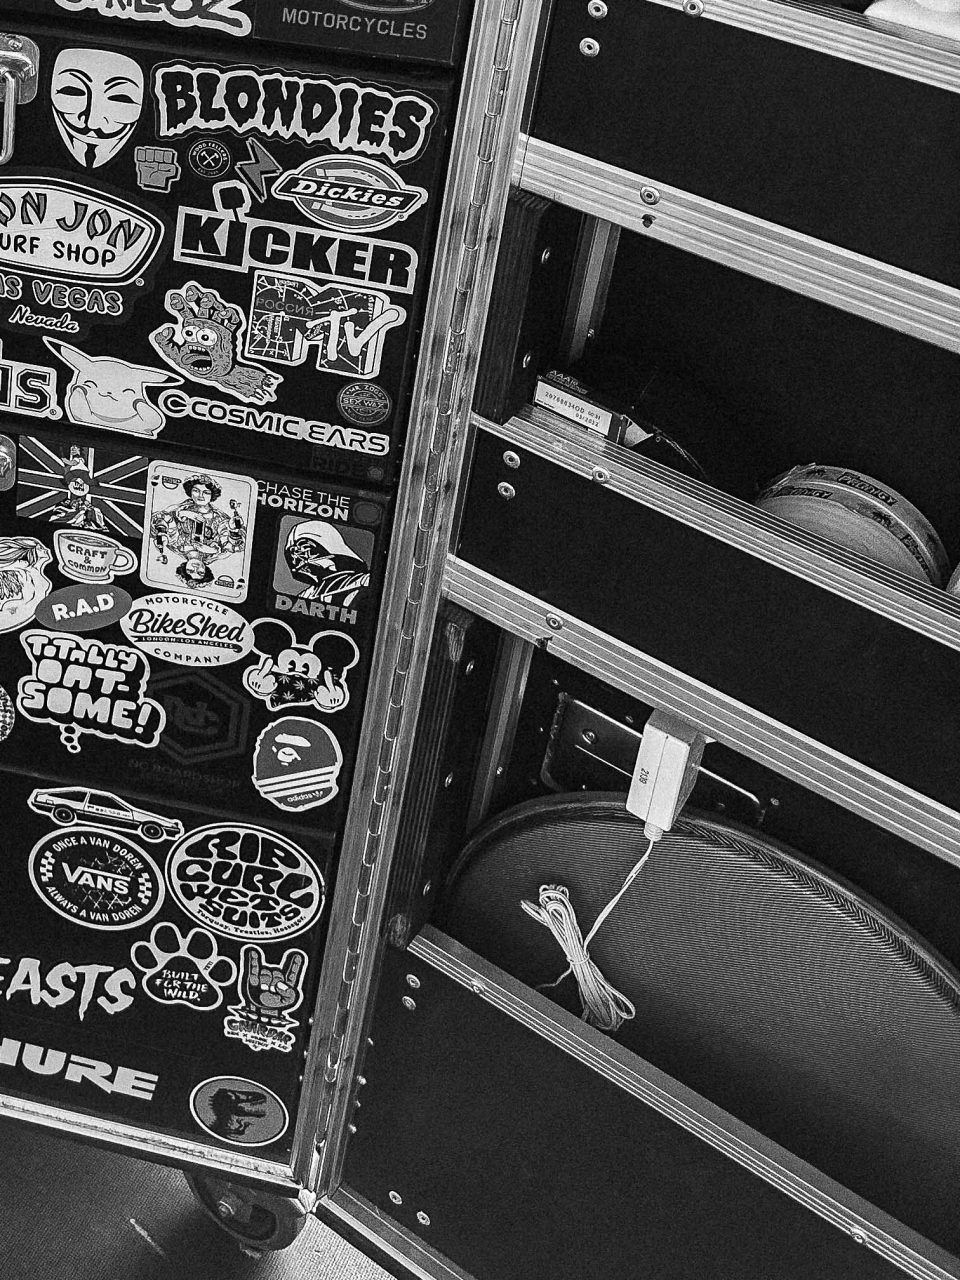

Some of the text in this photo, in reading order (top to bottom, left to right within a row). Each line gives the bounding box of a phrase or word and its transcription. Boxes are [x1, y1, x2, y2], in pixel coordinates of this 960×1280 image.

[282, 8, 428, 40] MOTORCYCLES
[160, 70, 428, 162] BLONDIES
[291, 180, 405, 207] Dickies
[56, 200, 145, 252] JON
[53, 241, 116, 267] SHOP
[179, 207, 415, 292] KICKER
[31, 280, 124, 315] VEGAS
[9, 305, 80, 333] Nevada
[191, 401, 301, 438] COSMIC
[255, 480, 351, 509] CHASE THE
[256, 493, 349, 521] HORIZON
[67, 544, 108, 559] CRAFT
[145, 597, 229, 615] MOTORCYCLE
[275, 594, 358, 625] DARTH
[128, 609, 247, 643] BikeShed
[154, 648, 221, 663] COMPANY
[22, 681, 153, 734] SOME!
[287, 791, 313, 803] adidas
[52, 836, 144, 870] ONCE VAN DOREN
[61, 861, 131, 895] VANS
[46, 886, 143, 922] ALWAYS VAN DOREN
[162, 969, 199, 980] BUILT
